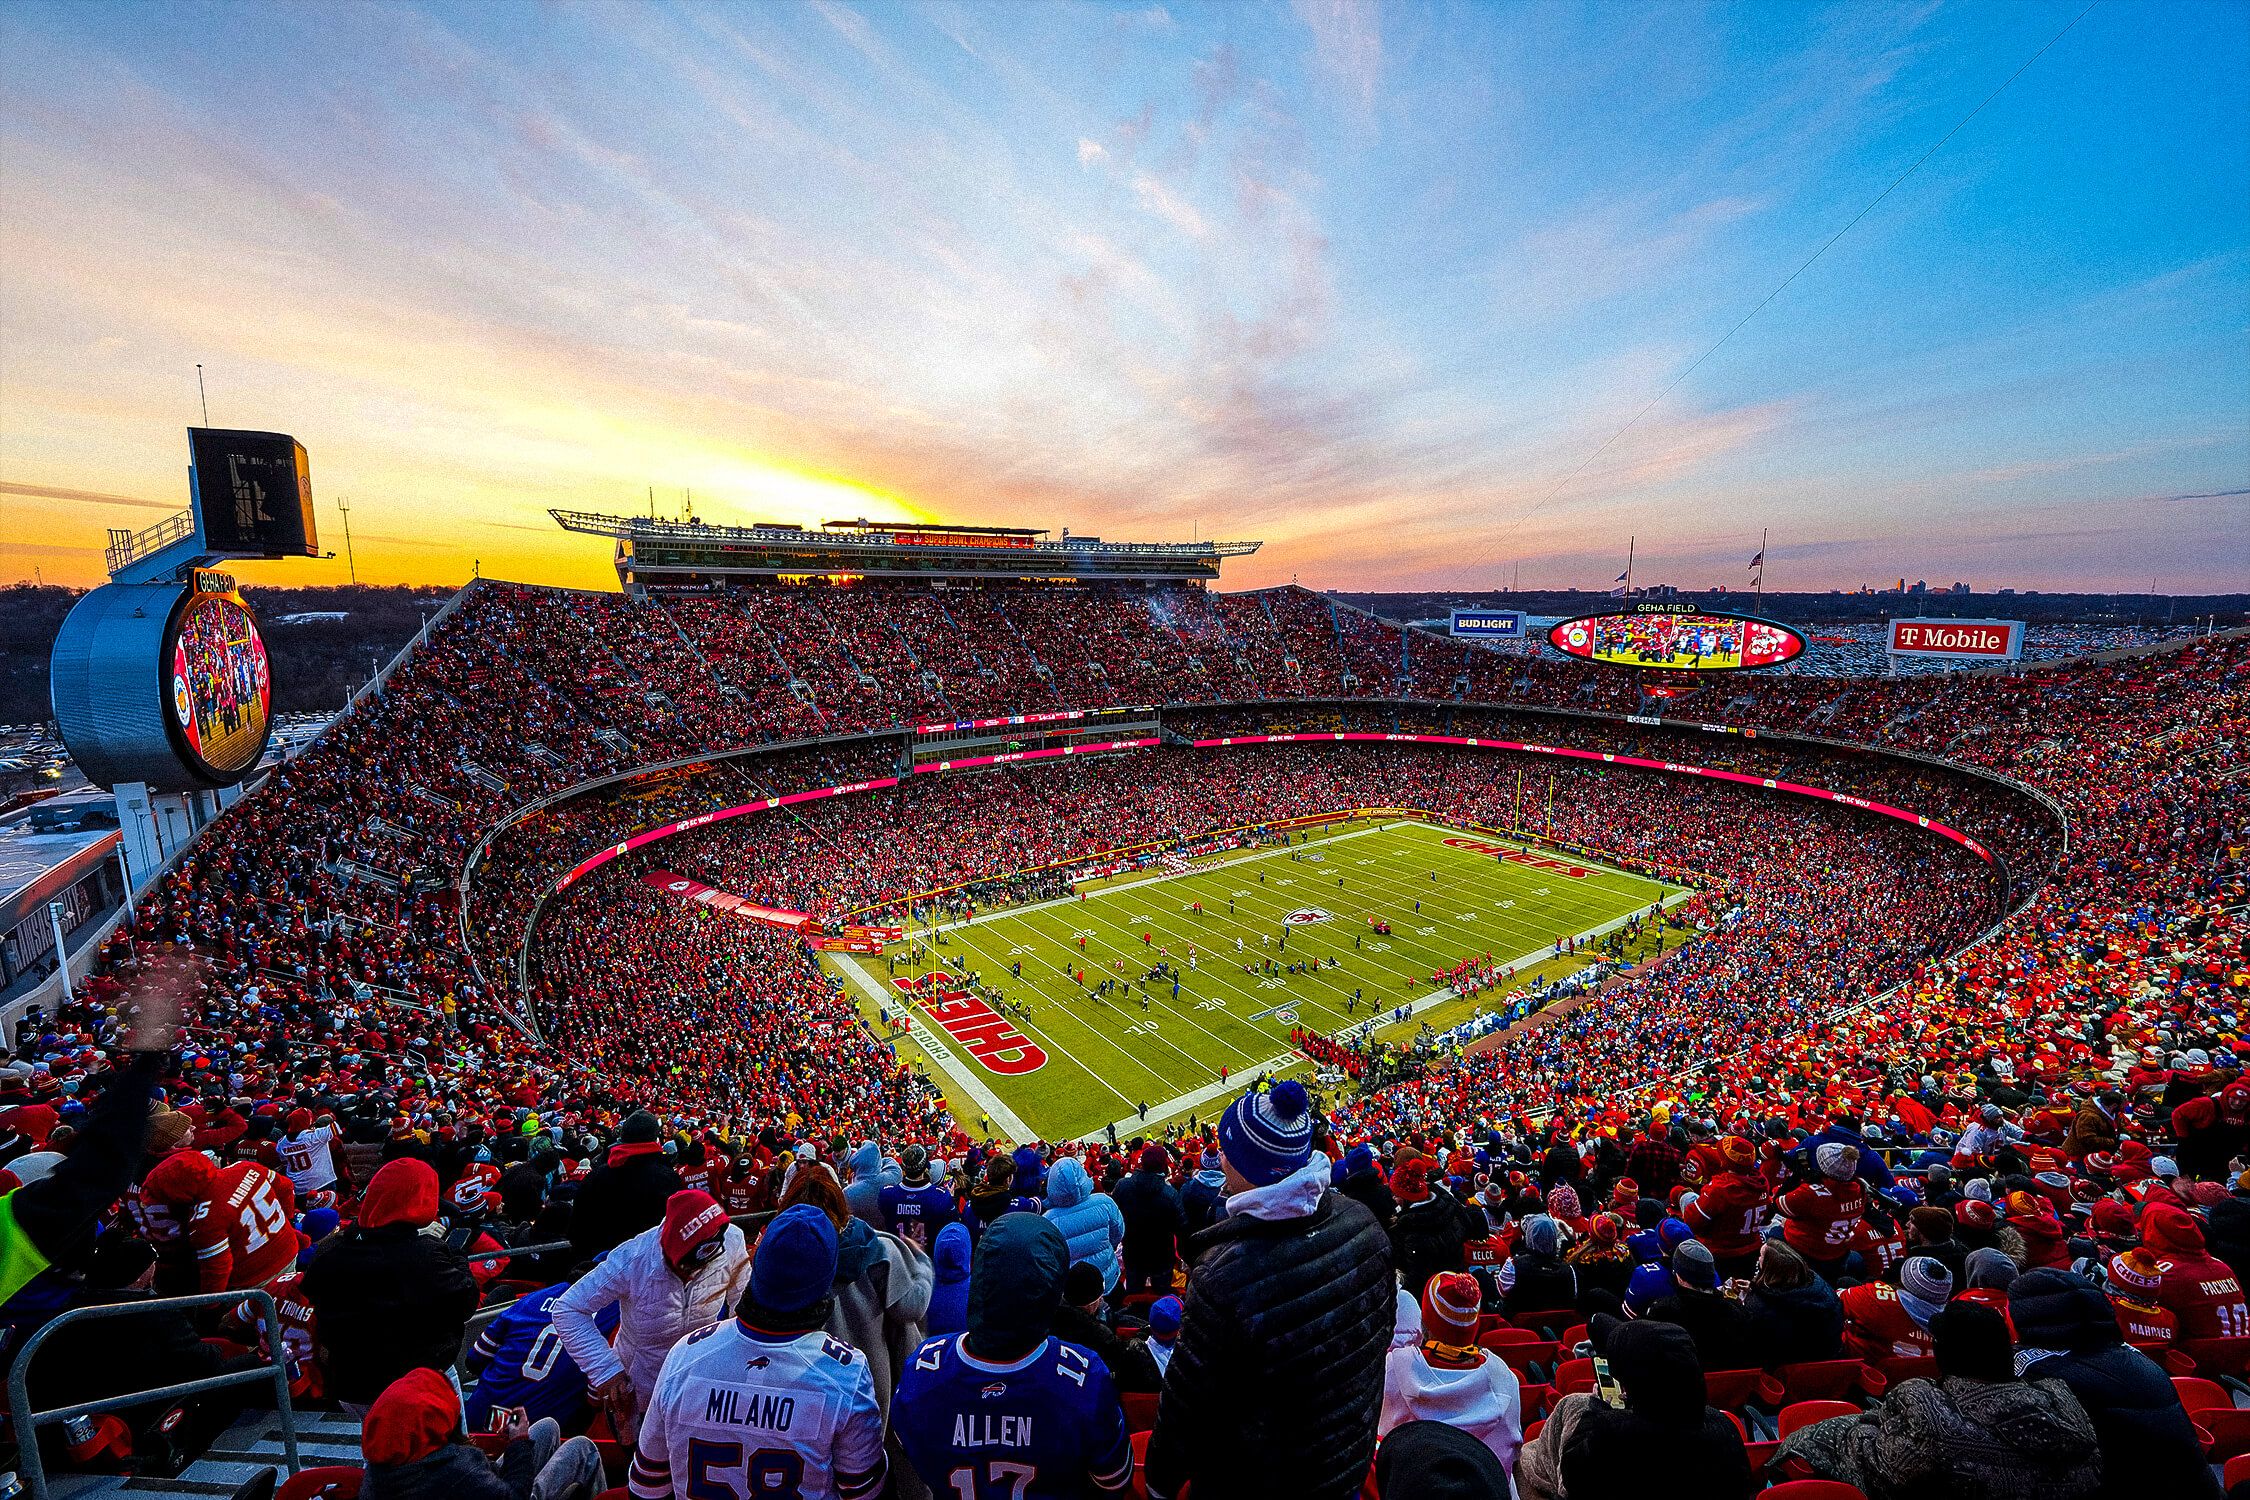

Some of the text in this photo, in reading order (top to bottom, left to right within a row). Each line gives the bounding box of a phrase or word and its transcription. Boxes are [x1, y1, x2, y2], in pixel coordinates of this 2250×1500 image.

[1638, 604, 1695, 613] GEHA FIELD
[1459, 619, 1513, 629] BUD LIGHT
[1901, 628, 2000, 649] T Mobile
[1441, 838, 1605, 879] CHIEFS
[1368, 942, 1391, 953] 50
[1262, 977, 1287, 990] 30
[1199, 997, 1227, 1012] 20
[891, 971, 1048, 1075] CHIEFS
[1128, 1020, 1160, 1036] 10
[911, 1025, 950, 1060] CHOOSE
[288, 1152, 313, 1172] 10
[227, 1169, 260, 1208] MAHOMES
[240, 1179, 286, 1254] 15
[897, 1203, 921, 1216] DIGGS
[1840, 1198, 1863, 1213] KELCE
[1740, 1204, 1768, 1235] 15
[1472, 1250, 1495, 1260] KELCE
[2115, 1262, 2161, 1288] CHIEFS
[279, 1299, 314, 1322] THOMAS
[2216, 1302, 2250, 1338] 10
[2129, 1322, 2172, 1339] MAHOMES
[916, 1338, 947, 1371] 17
[1056, 1345, 1089, 1387] 17
[705, 1388, 796, 1432] MILANO
[952, 1414, 1032, 1447] ALLEN
[687, 1437, 805, 1500] 58
[949, 1460, 1036, 1500] 17
